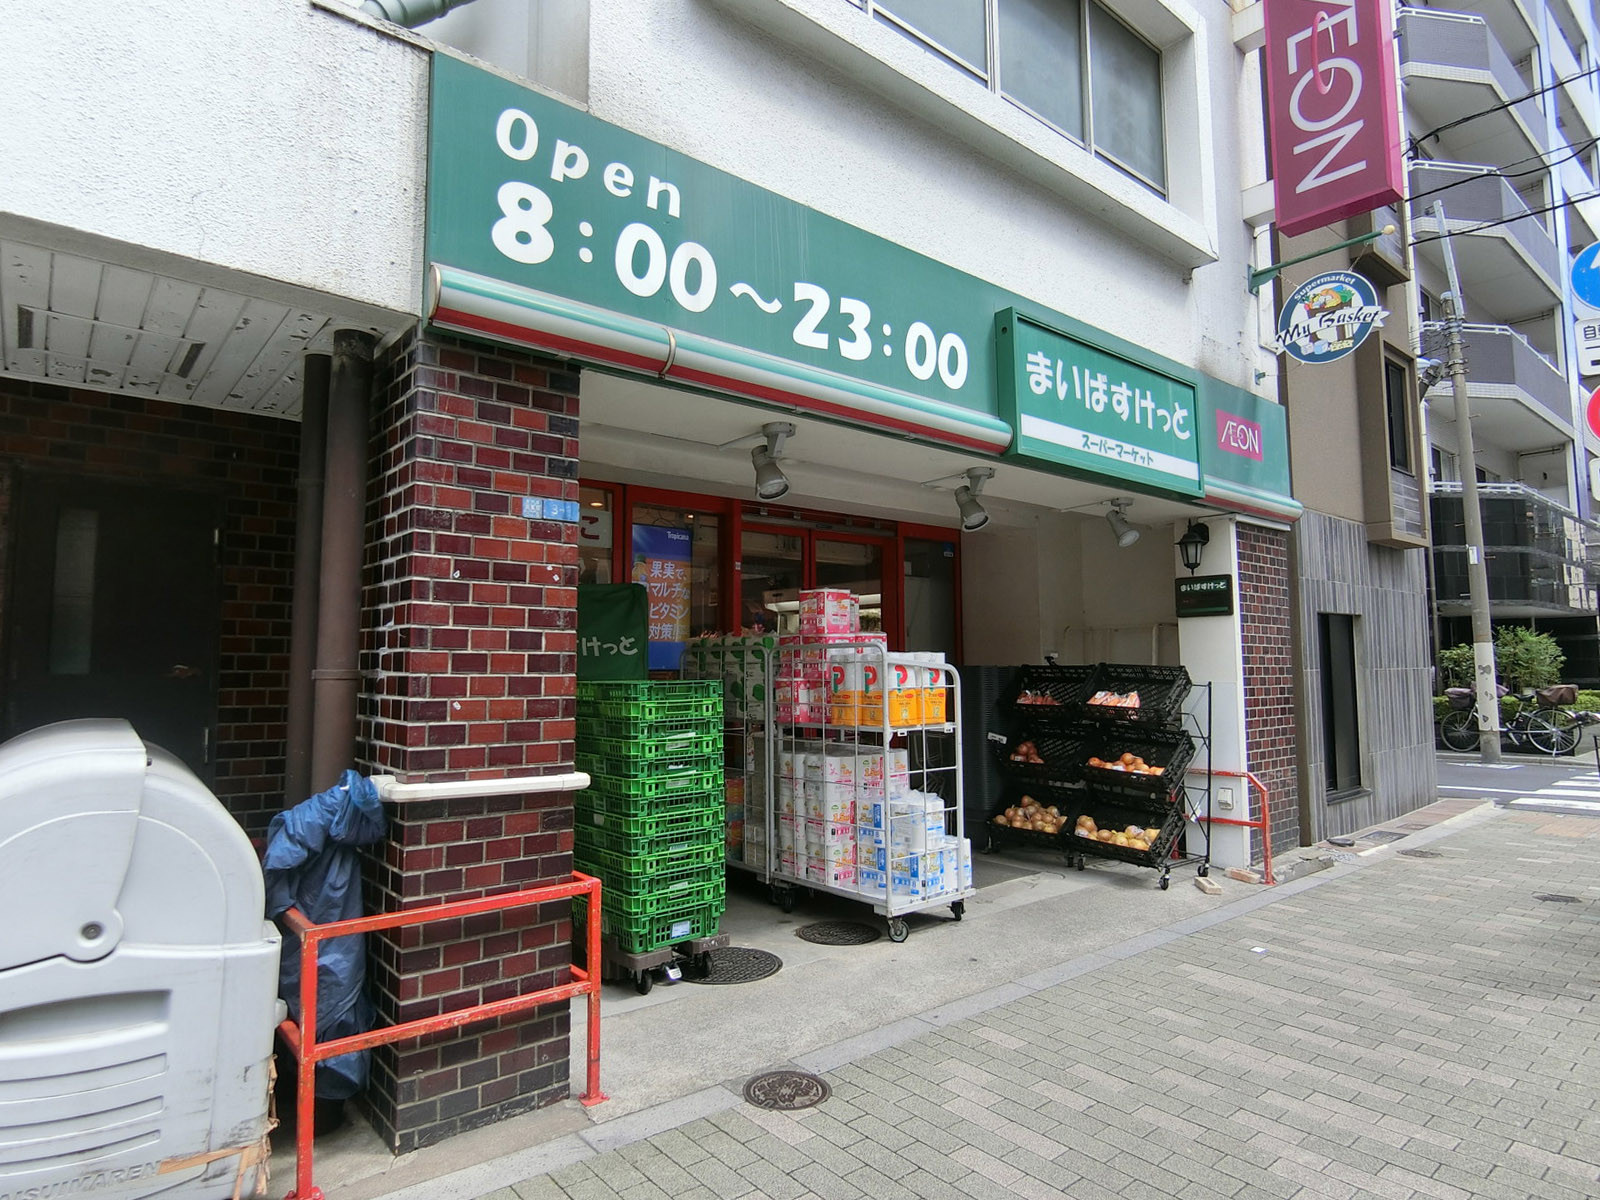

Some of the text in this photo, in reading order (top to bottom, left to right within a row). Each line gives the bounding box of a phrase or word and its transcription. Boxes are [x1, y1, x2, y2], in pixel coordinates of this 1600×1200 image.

[496, 108, 681, 218] Open
[1294, 274, 1356, 301] Supermarket
[1276, 306, 1380, 346] My Basket
[1026, 351, 1191, 440] まいばすけっと
[1082, 434, 1154, 466] スーパーマーケット
[666, 530, 689, 541] Tropicana
[650, 582, 690, 599] マルチな
[1180, 582, 1226, 591] まいばすけっと
[650, 602, 689, 620] ビタミン
